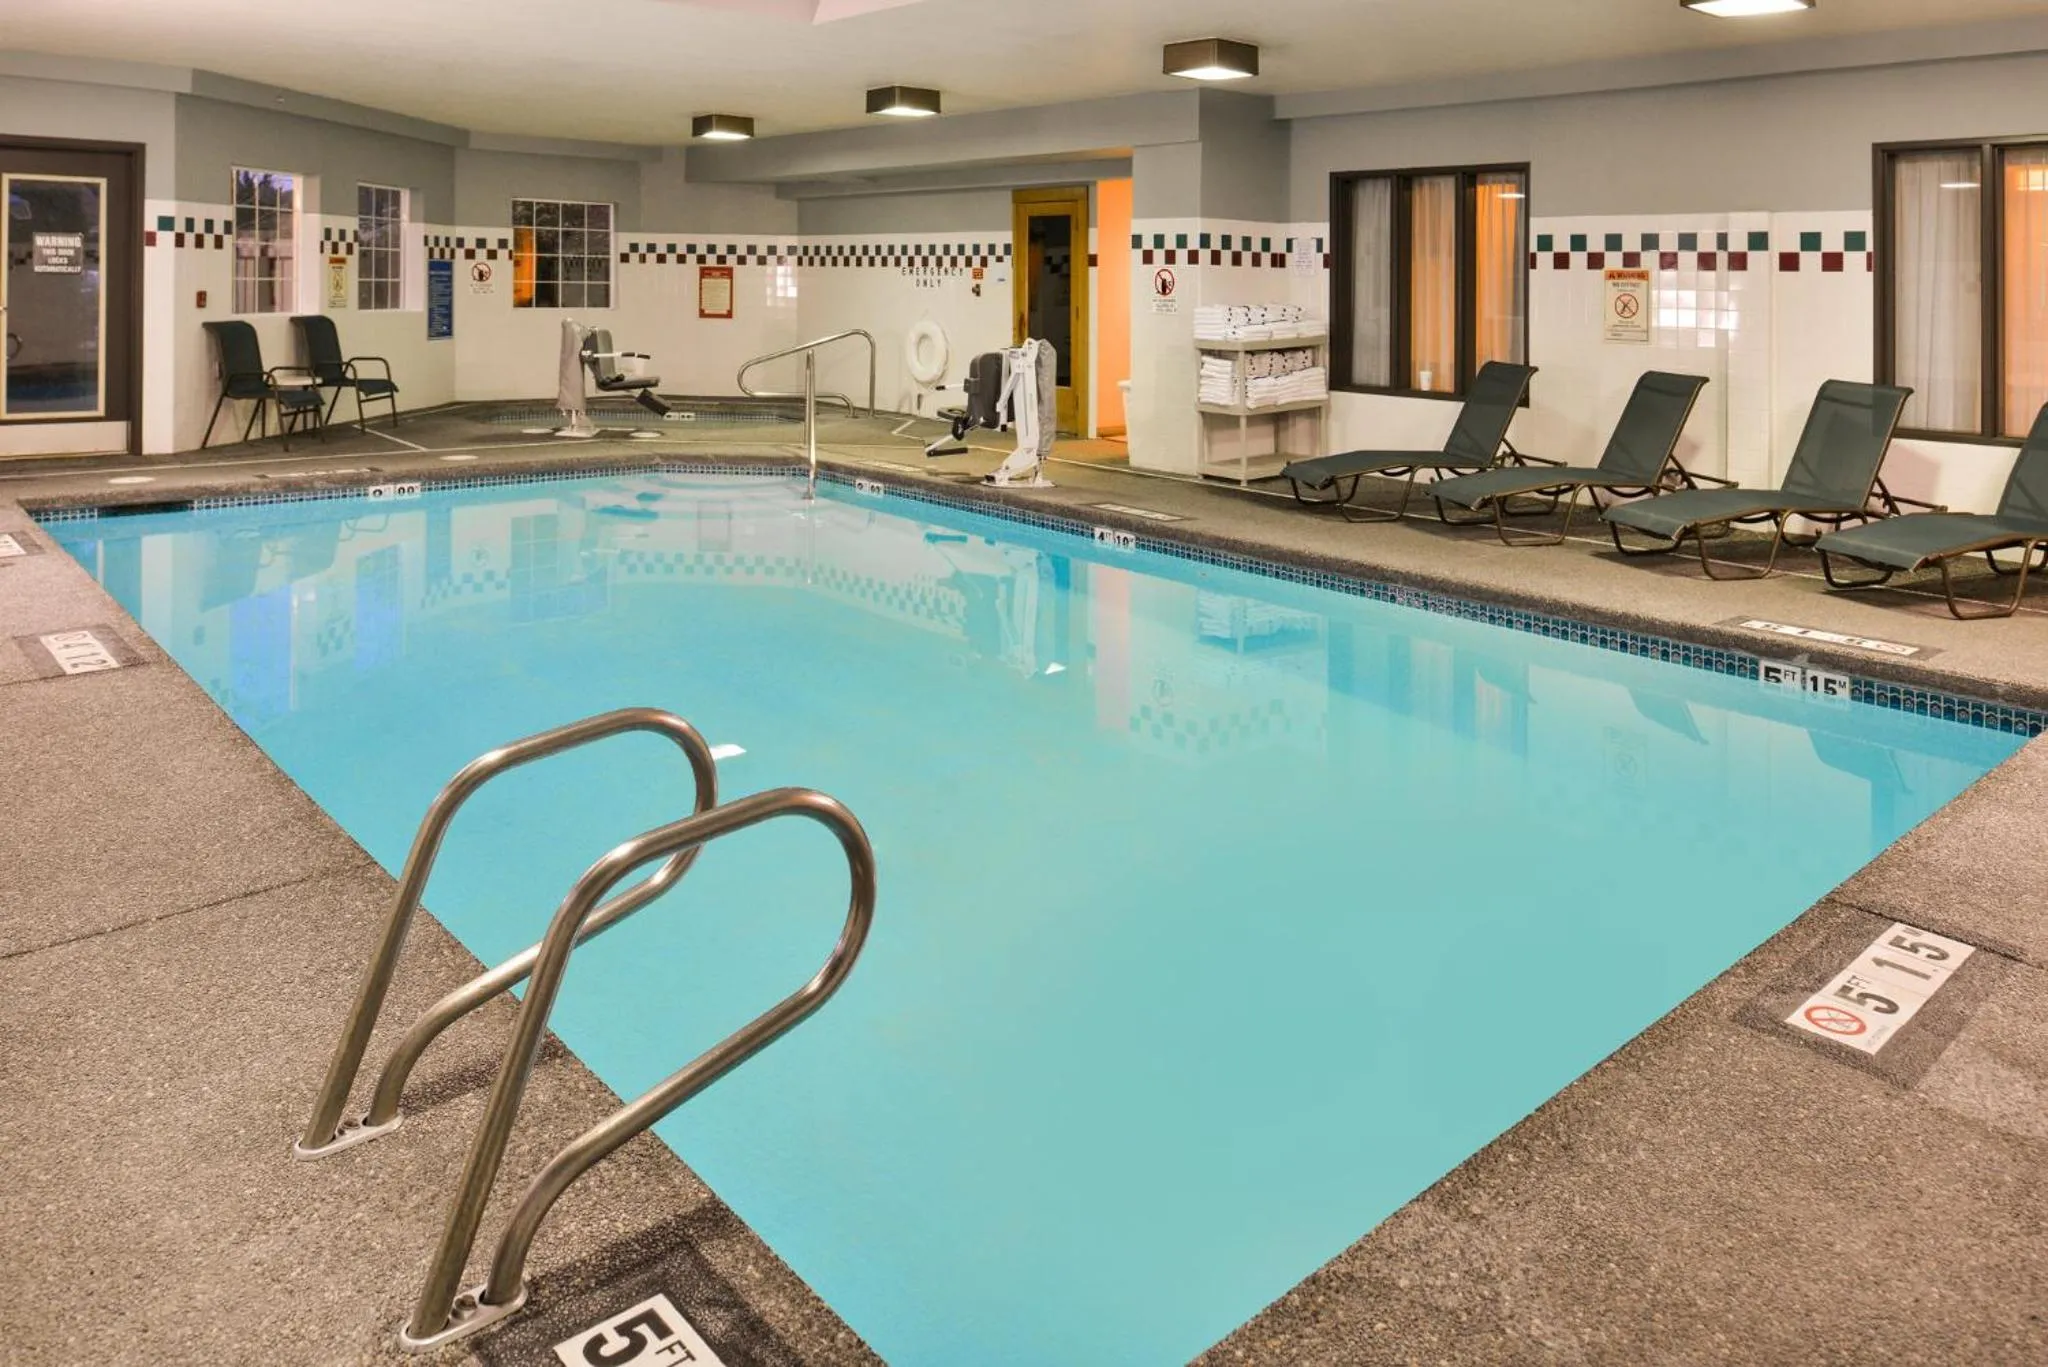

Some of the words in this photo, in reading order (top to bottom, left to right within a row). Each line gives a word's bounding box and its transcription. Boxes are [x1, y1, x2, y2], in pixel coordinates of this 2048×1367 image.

[35, 236, 81, 247] WARNING
[34, 265, 81, 273] AUTOMATICALLY
[902, 267, 963, 276] EMERGENCY
[916, 279, 941, 288] ONLY
[1764, 666, 1782, 683] 5
[1783, 670, 1796, 682] FT
[1833, 984, 1900, 1015] 5
[582, 1307, 674, 1367] 5
[655, 1339, 696, 1367] FT
